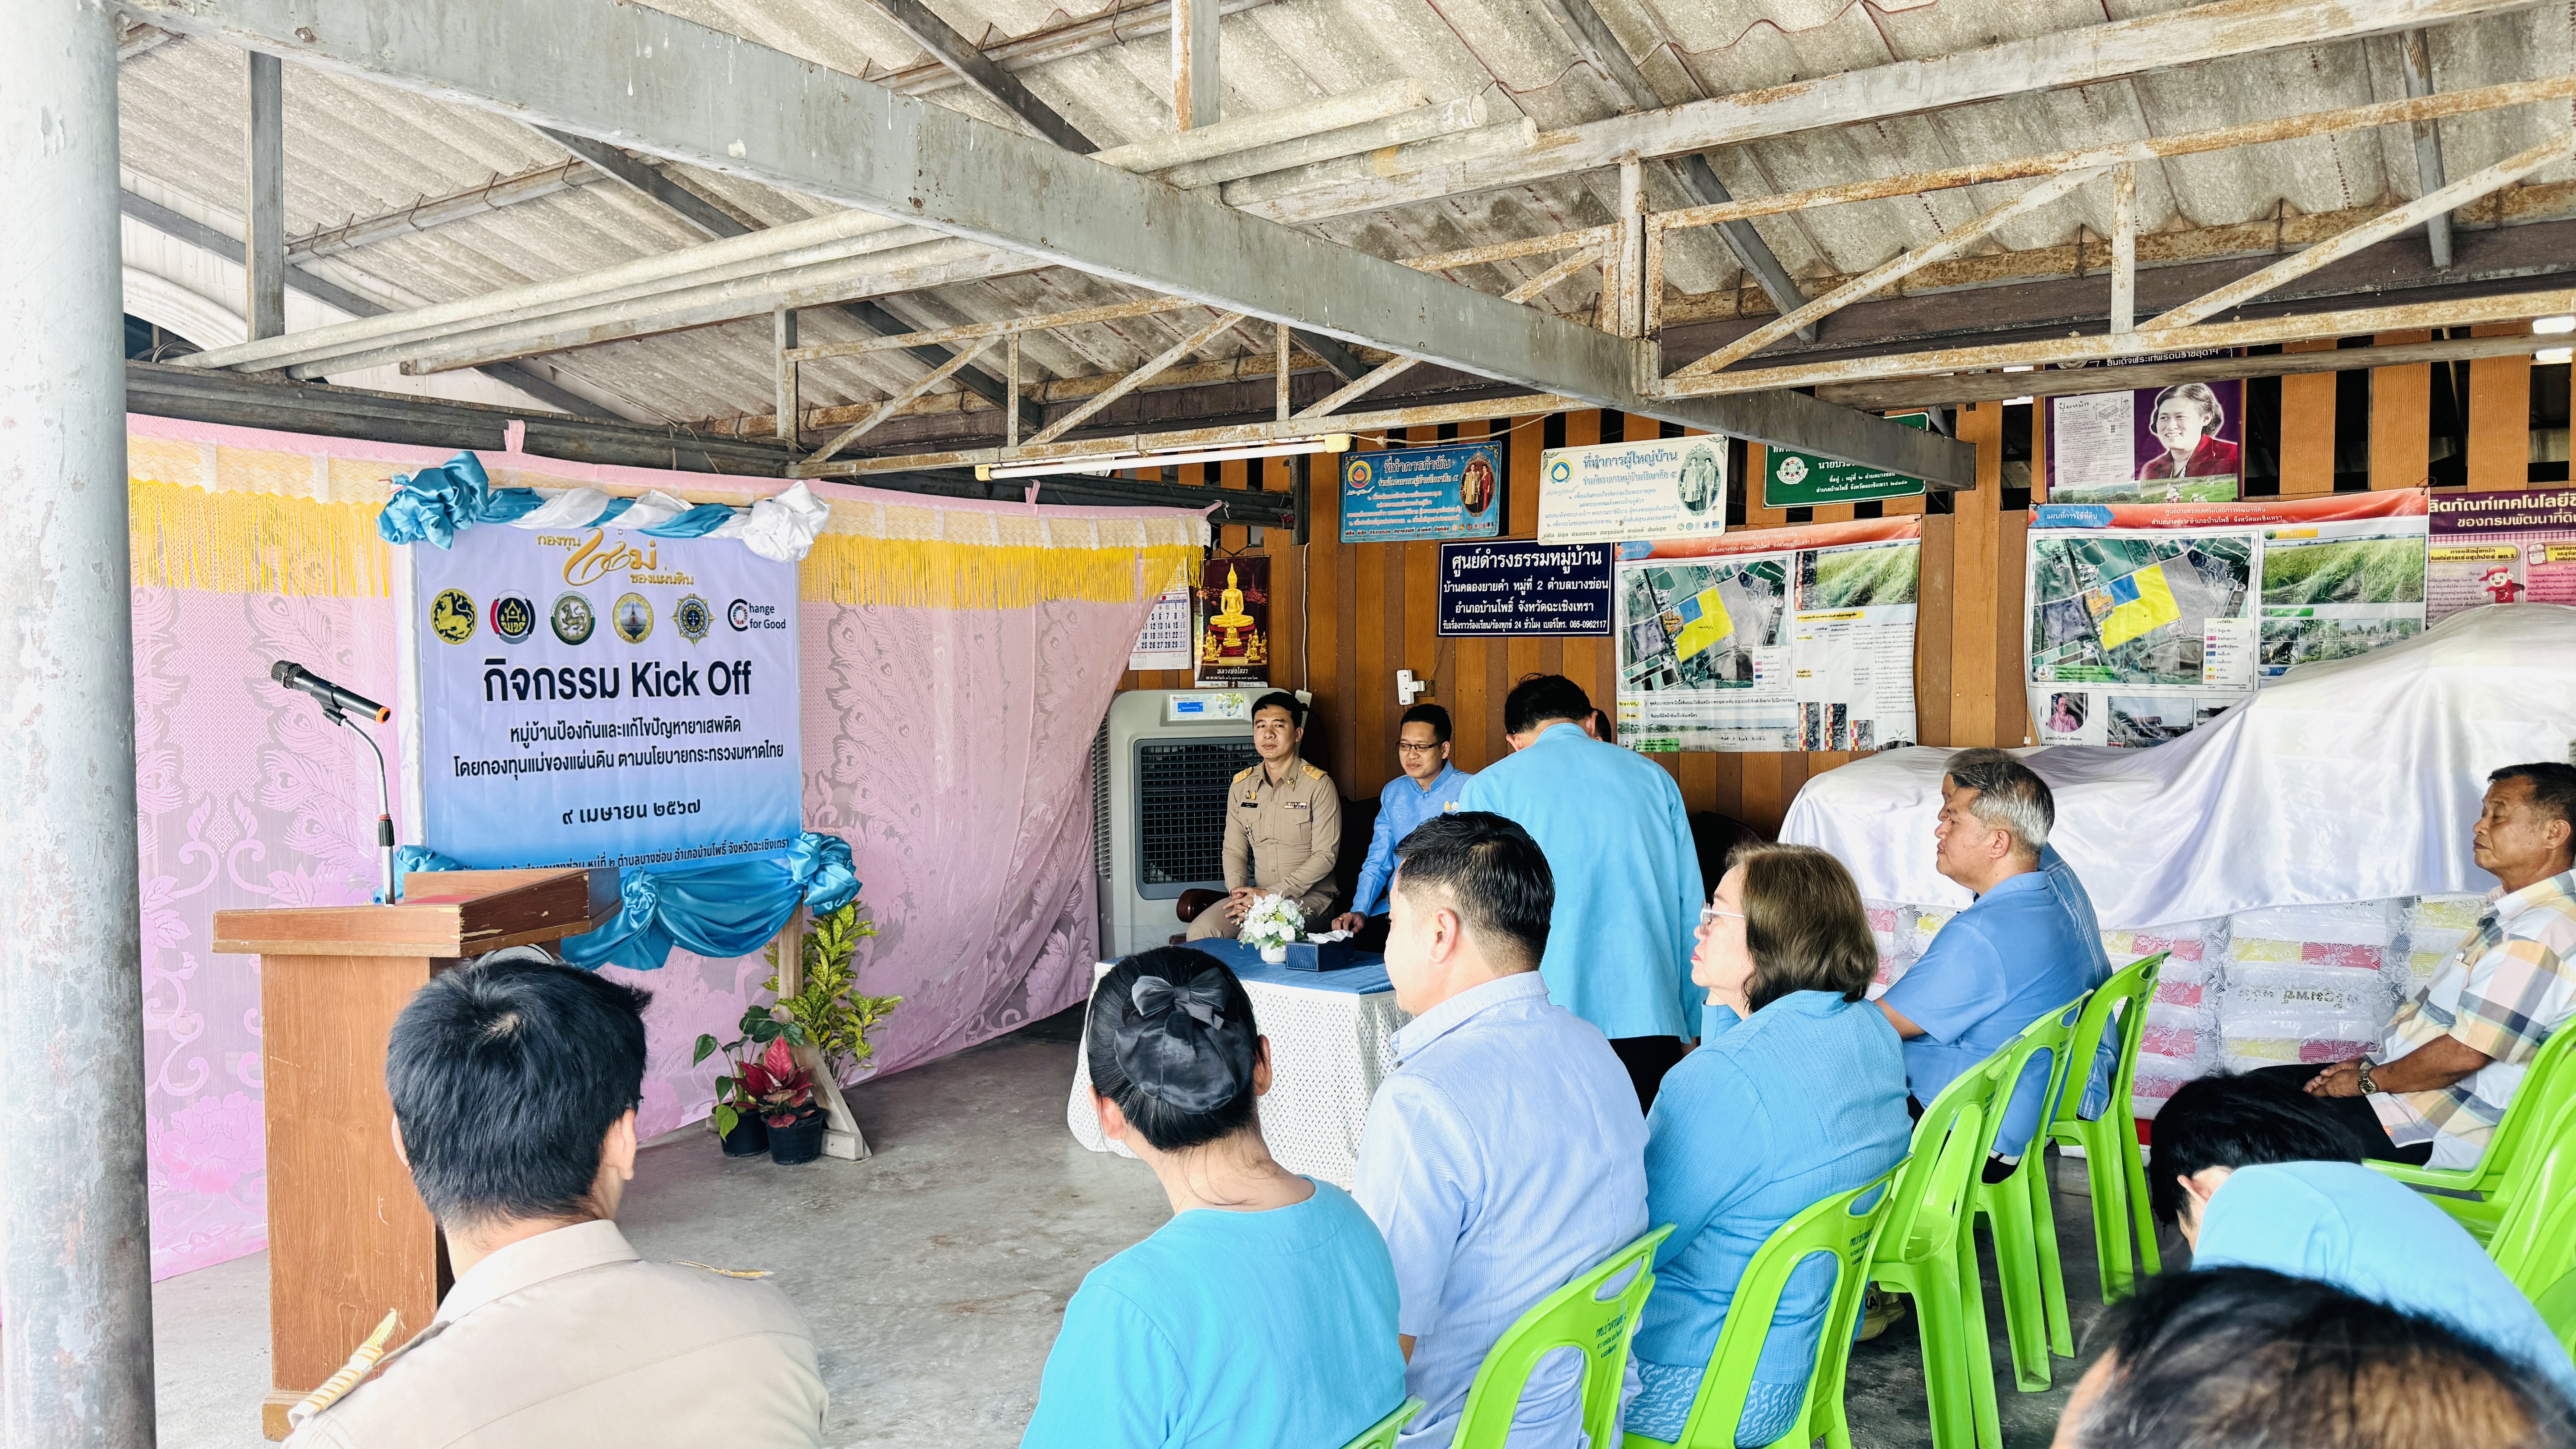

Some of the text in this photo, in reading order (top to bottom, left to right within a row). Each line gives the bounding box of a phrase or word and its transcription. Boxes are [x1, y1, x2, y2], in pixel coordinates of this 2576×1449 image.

[1384, 455, 1451, 474] ที่ทำการกำนัน
[1583, 448, 1678, 470] ที่ทำการผู้ใหญ่บ้าน
[2047, 510, 2098, 521] แผนที่การใช้ที่ดิน
[537, 535, 580, 551] กองทุน
[1452, 545, 1602, 577] ศูนย์ดำรงธรรมหมู่บ้าน
[630, 566, 694, 585] ของแผ่นดิน
[1444, 575, 1609, 595] บ้านคลองยายคำ หมู่ที่ 2 ตำบลบางซ่อน
[1455, 596, 1594, 613] อำเภอบ้านโพธิ์ จังหวัดฉะเชิงเทรา
[750, 619, 786, 630] for Good
[1523, 616, 1541, 629] ชั่วโมง
[1543, 617, 1567, 629] เบอร์โทร.
[1569, 620, 1606, 629] 085-0962117
[484, 658, 752, 701] กิจกรรม Kick Off
[511, 715, 741, 748] หมู่บ้านป้องกันและแก้ไขปัญหายาเสพติด
[454, 740, 784, 780] โดยกองทุนแม่ของแผ่นดิน ตามนโยบายกระทรวงมหาดไทย
[562, 798, 701, 825] ๙ เมษายน ๒๕๖๗
[618, 849, 673, 868] ตำบลบางซ่อน
[674, 839, 727, 863] อำเภอบ้านโพธิ์
[728, 837, 790, 855] จังหวัดฉะเชิงเทรา
